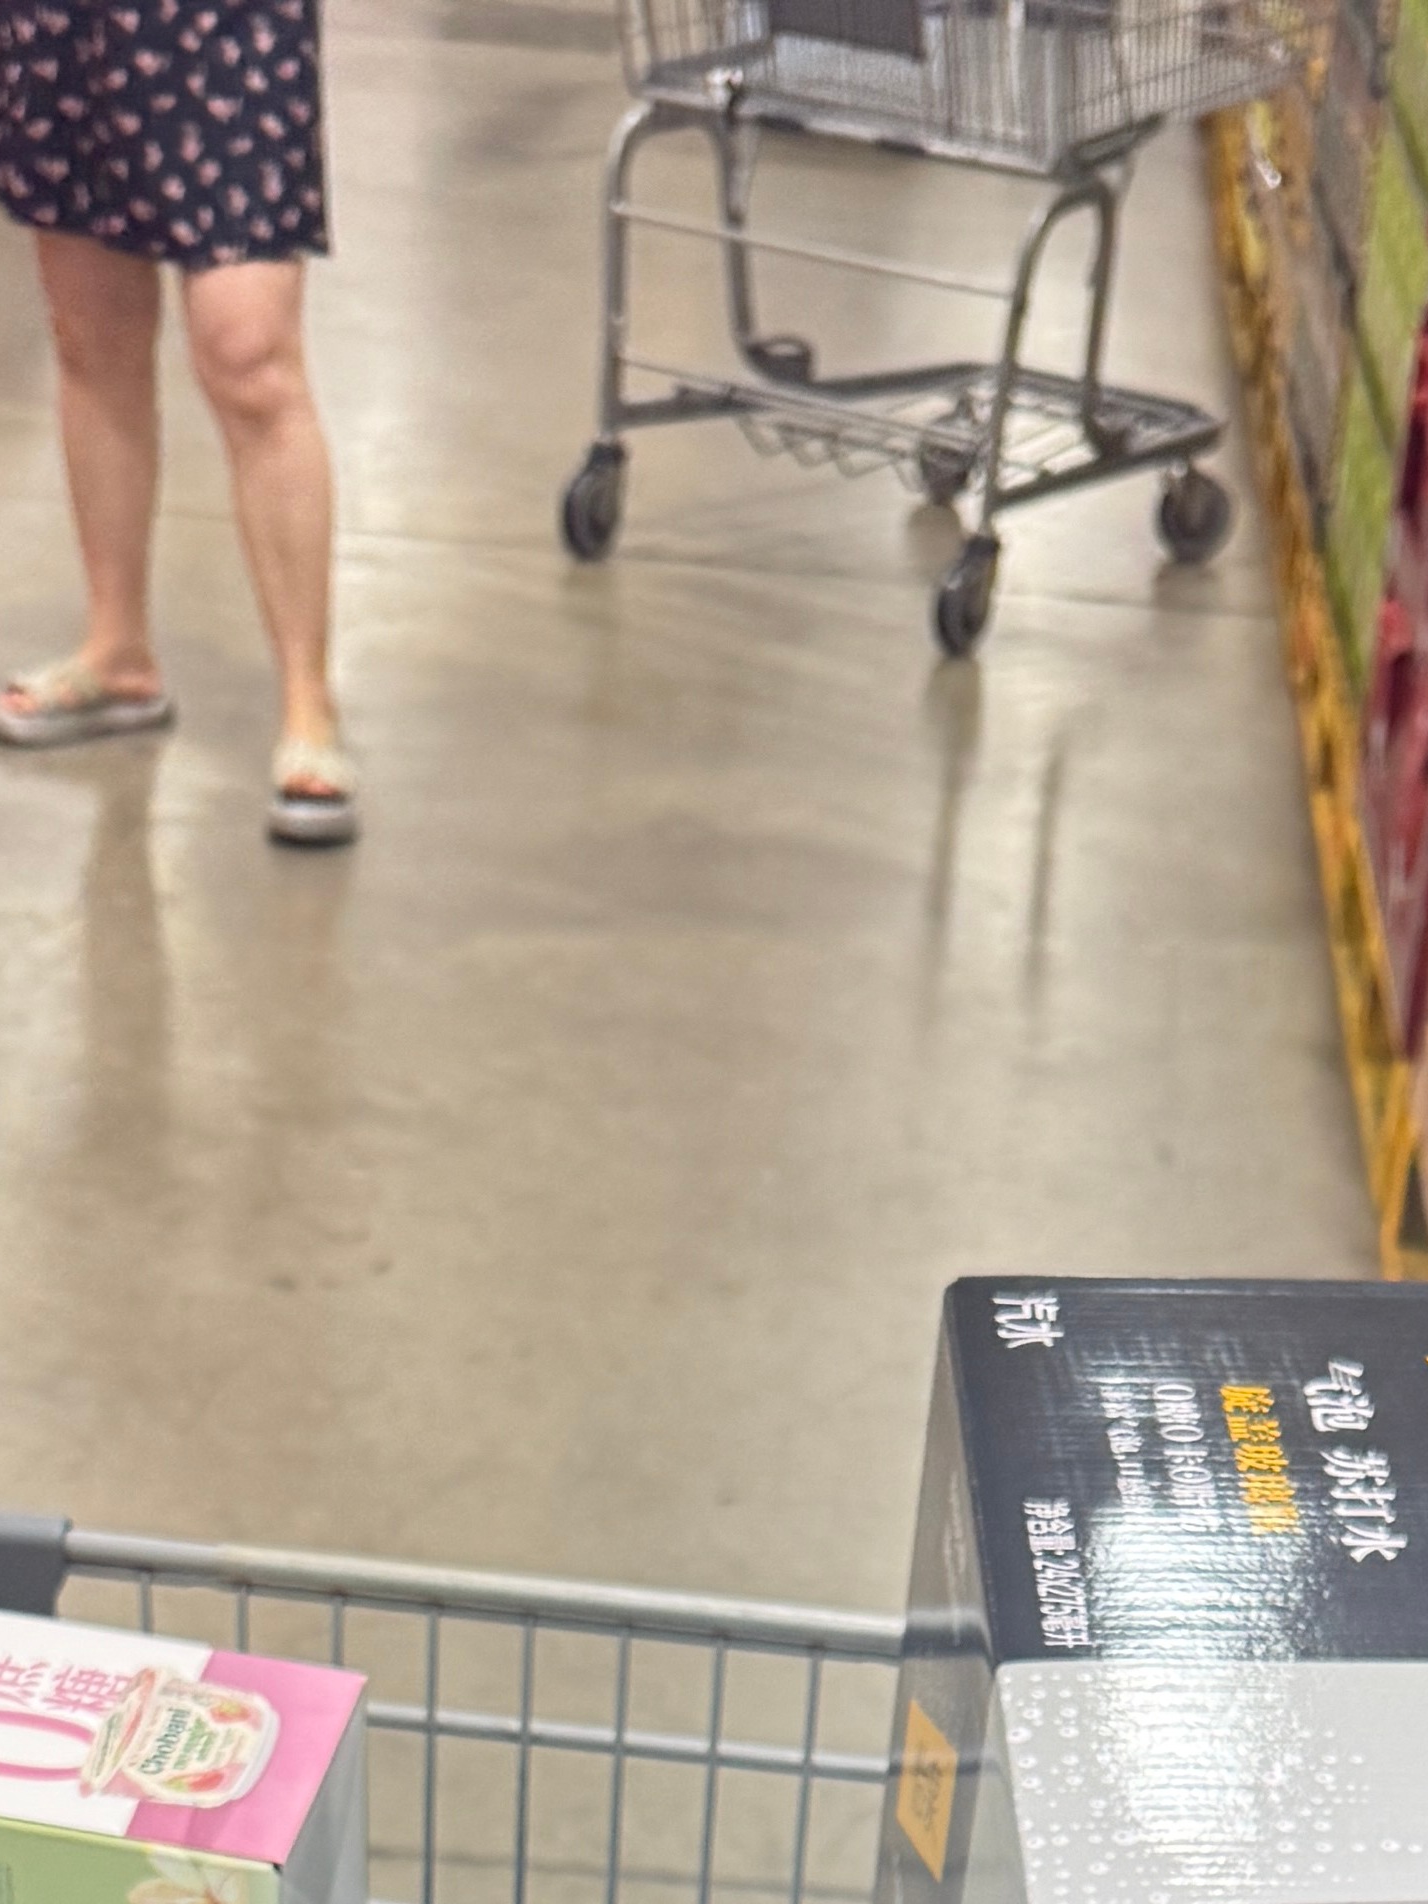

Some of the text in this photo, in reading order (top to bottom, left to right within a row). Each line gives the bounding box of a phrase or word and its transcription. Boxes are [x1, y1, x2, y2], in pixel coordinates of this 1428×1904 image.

[1303, 1356, 1409, 1564] 气泡 苏打水
